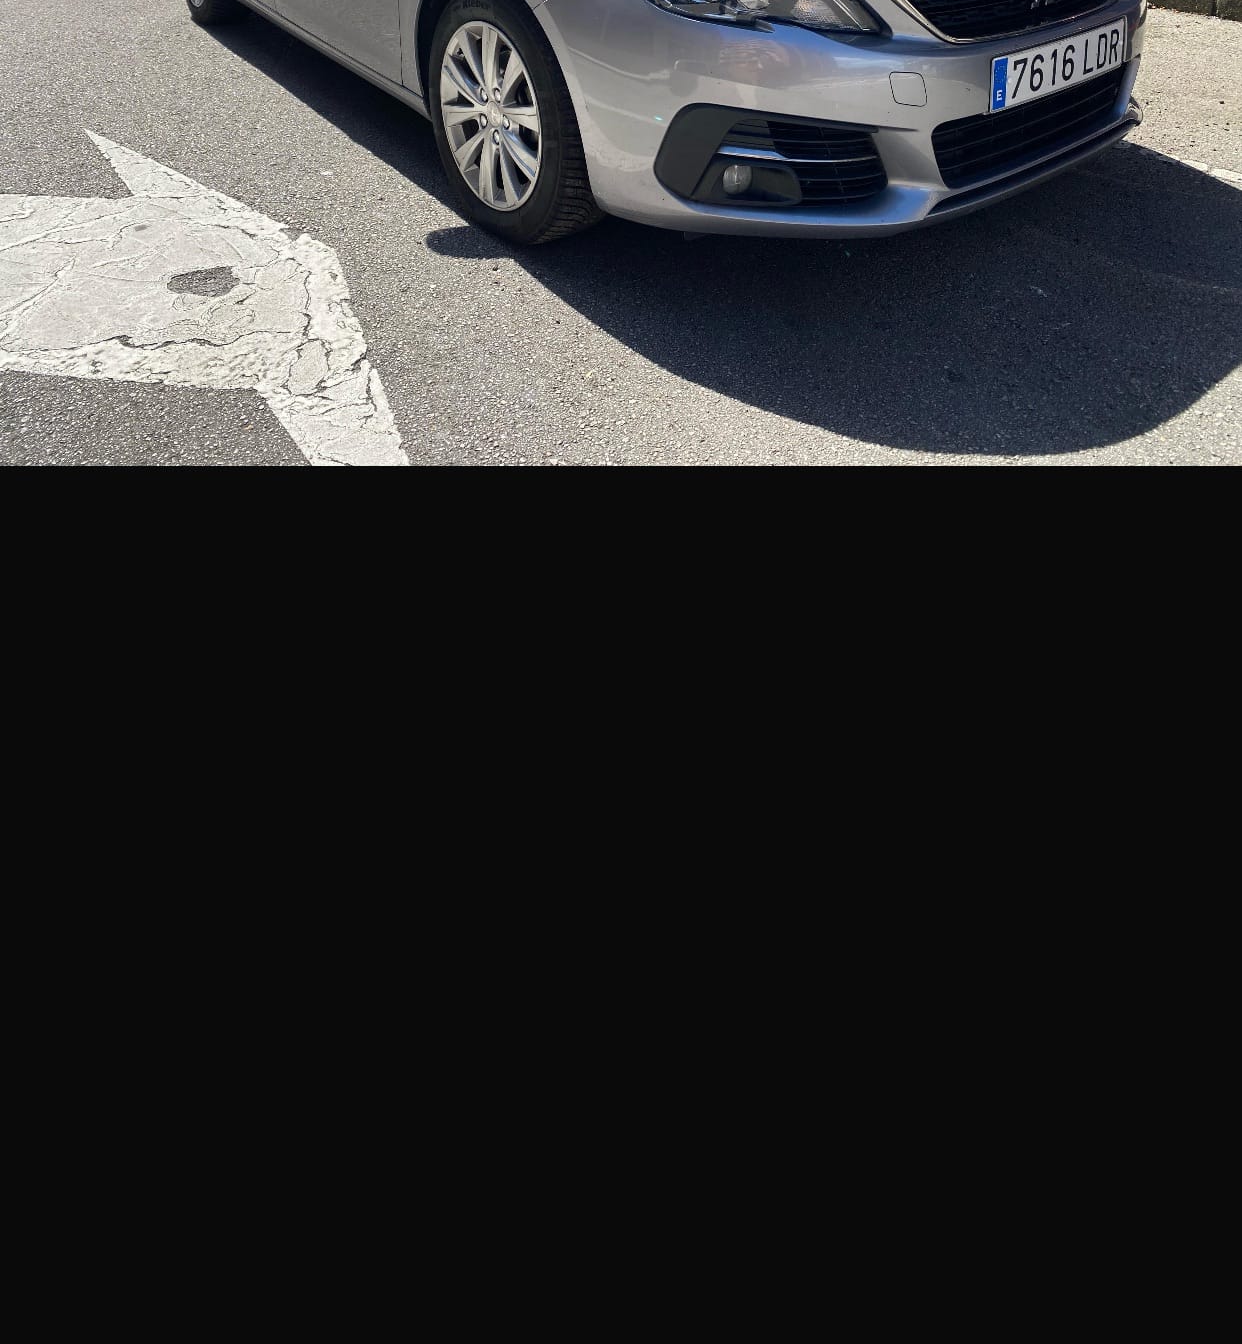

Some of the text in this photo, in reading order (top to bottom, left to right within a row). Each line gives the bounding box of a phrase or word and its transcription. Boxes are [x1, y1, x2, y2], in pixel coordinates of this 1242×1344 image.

[1011, 28, 1120, 99] 7616 LDR
[996, 89, 1003, 101] E
